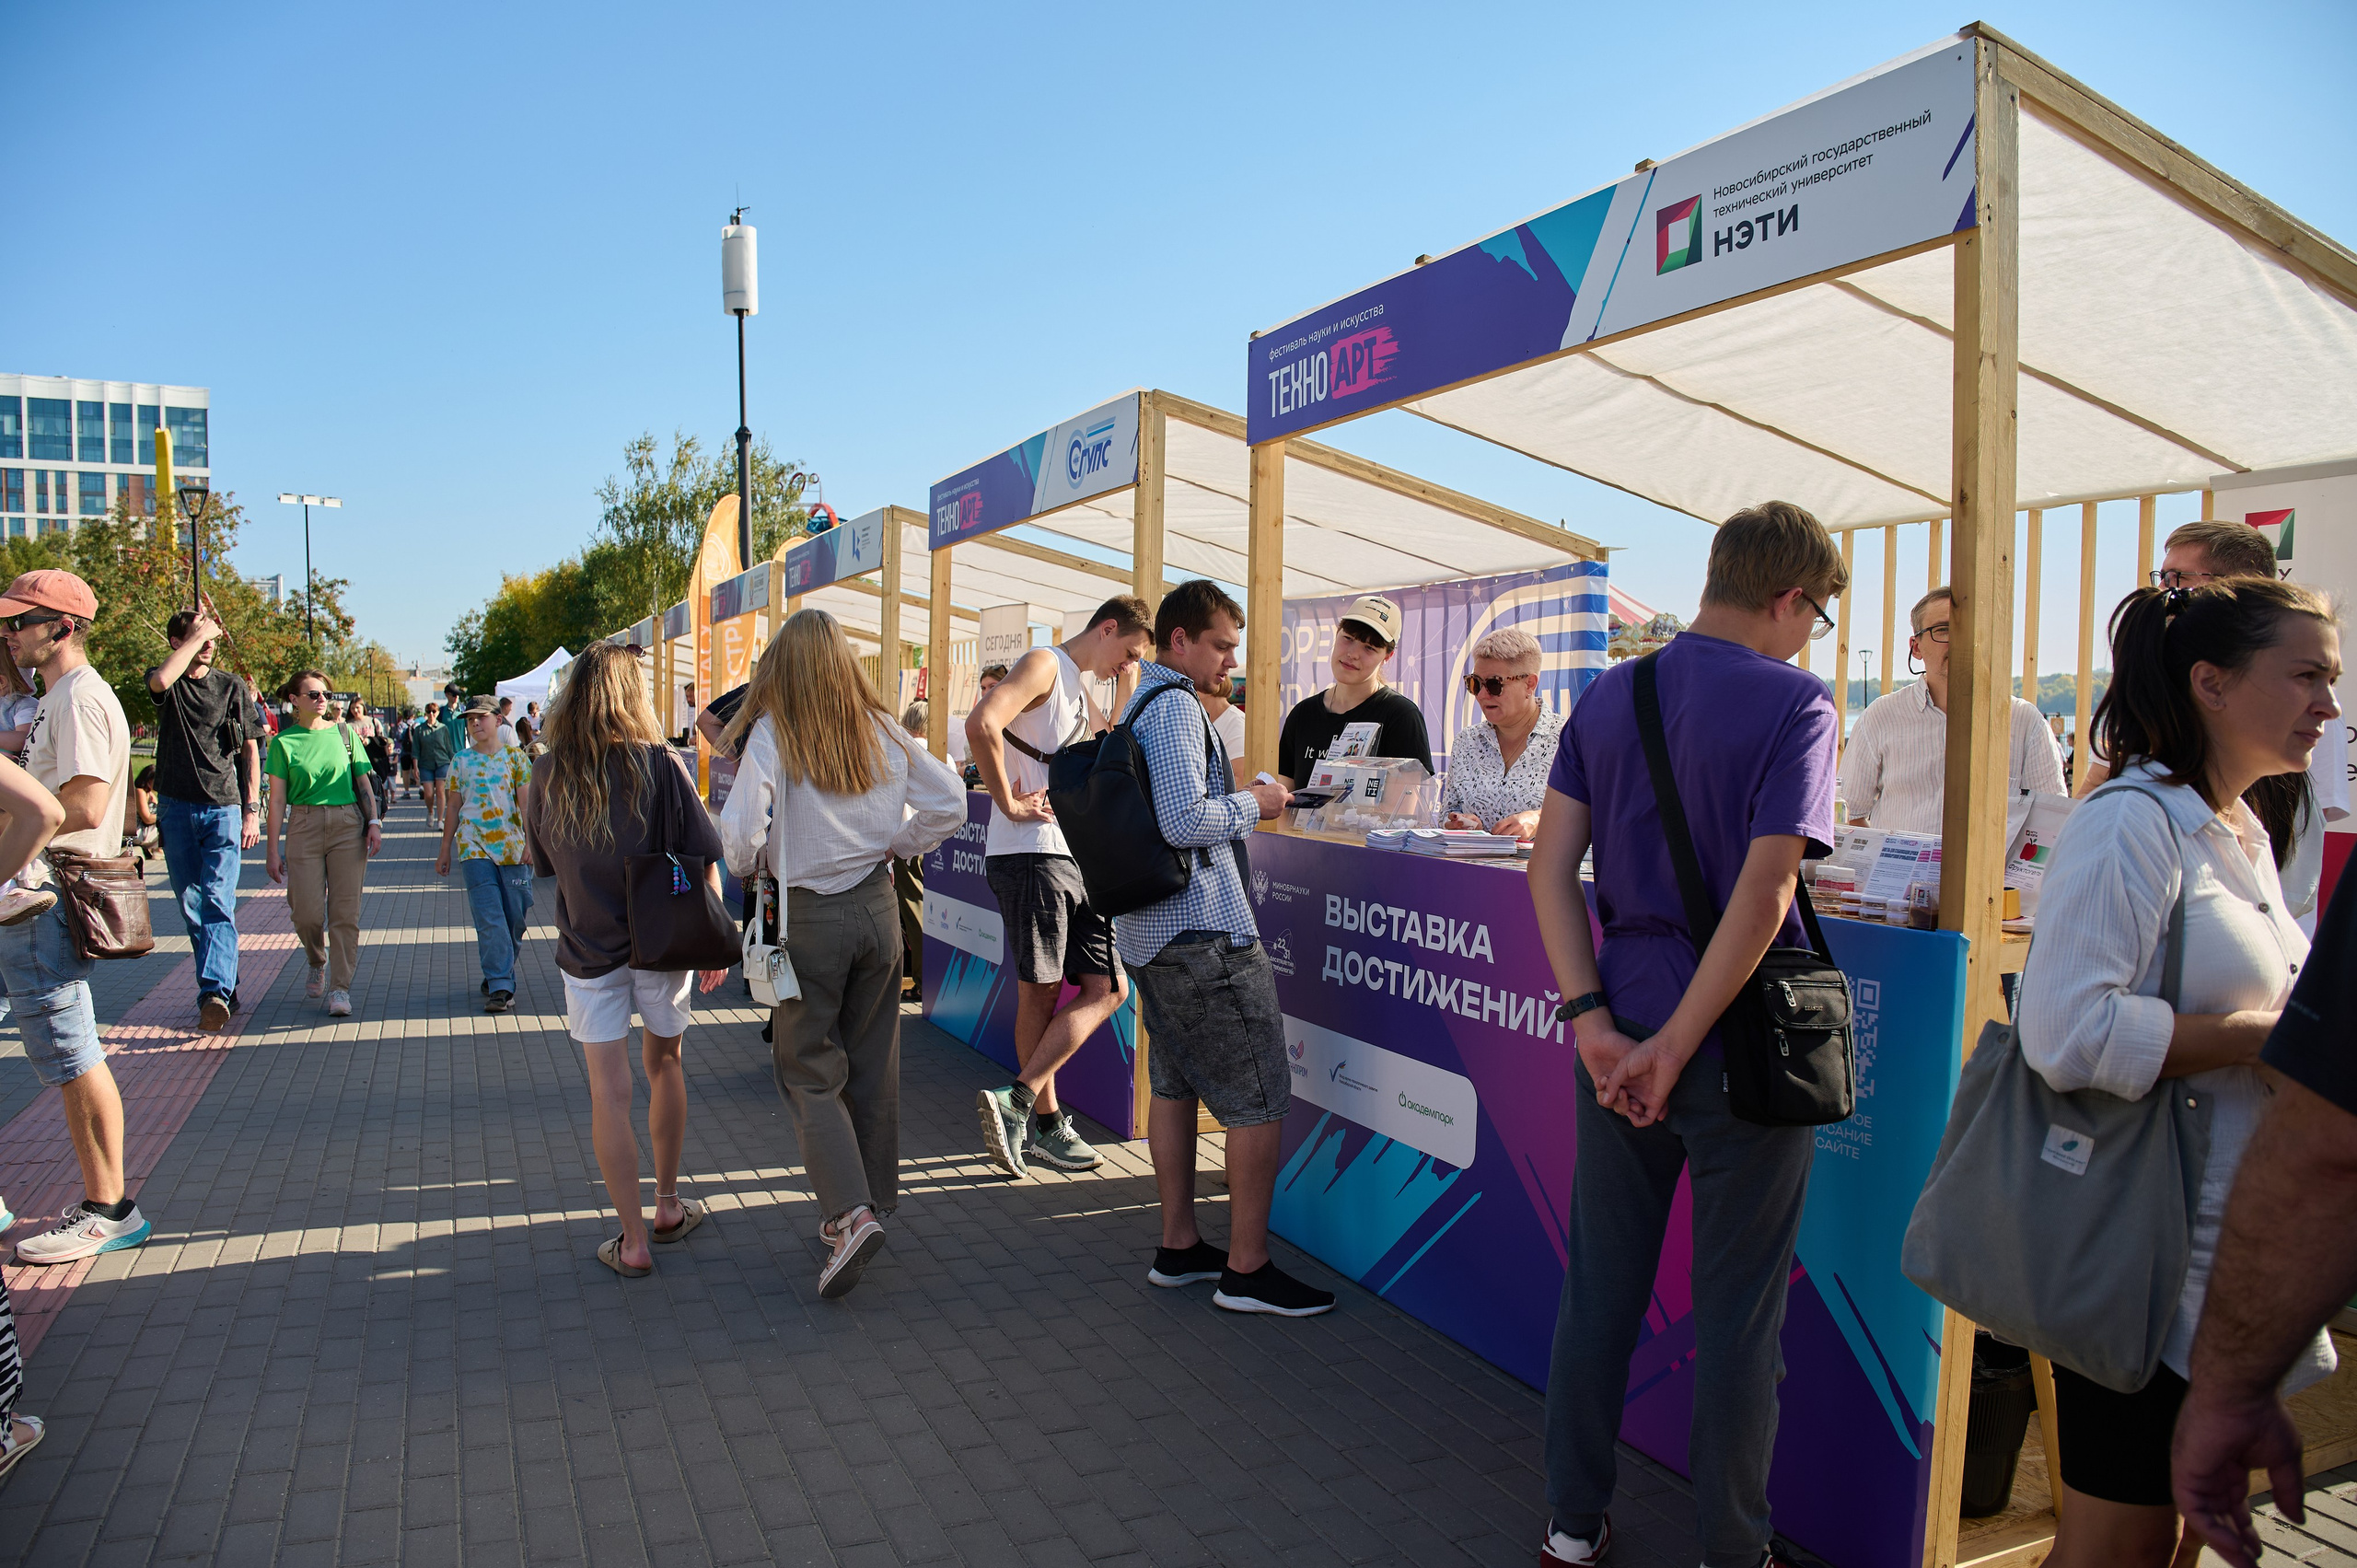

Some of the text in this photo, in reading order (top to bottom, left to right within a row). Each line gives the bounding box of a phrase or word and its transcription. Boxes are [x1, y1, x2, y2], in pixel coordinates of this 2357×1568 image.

[1713, 109, 1932, 200] Новосибирский государственный
[1713, 153, 1874, 218] технический университет
[1713, 203, 1798, 257] НЭТИ
[1269, 304, 1384, 363] фестиваль науки и искусства
[985, 633, 1023, 654] СЕГОДНЯ
[1281, 625, 1337, 664] OPE
[1305, 746, 1315, 759] It
[1367, 788, 1377, 796] TI
[1368, 780, 1379, 788] NE
[953, 849, 987, 877] ДОСТИ
[1272, 881, 1310, 896] МИНОБРНАУКИ
[1272, 891, 1293, 902] РОССИИ
[1325, 893, 1494, 964] ВЫСТАВКА
[1322, 945, 1565, 1045] ДОСТИЖЕНИЙ
[1289, 1062, 1308, 1078] НОПРОМ
[1407, 1099, 1455, 1127] академпарк
[1815, 1122, 1873, 1146] ИСАНИЕ
[1815, 1136, 1861, 1160] САЙТЕ
